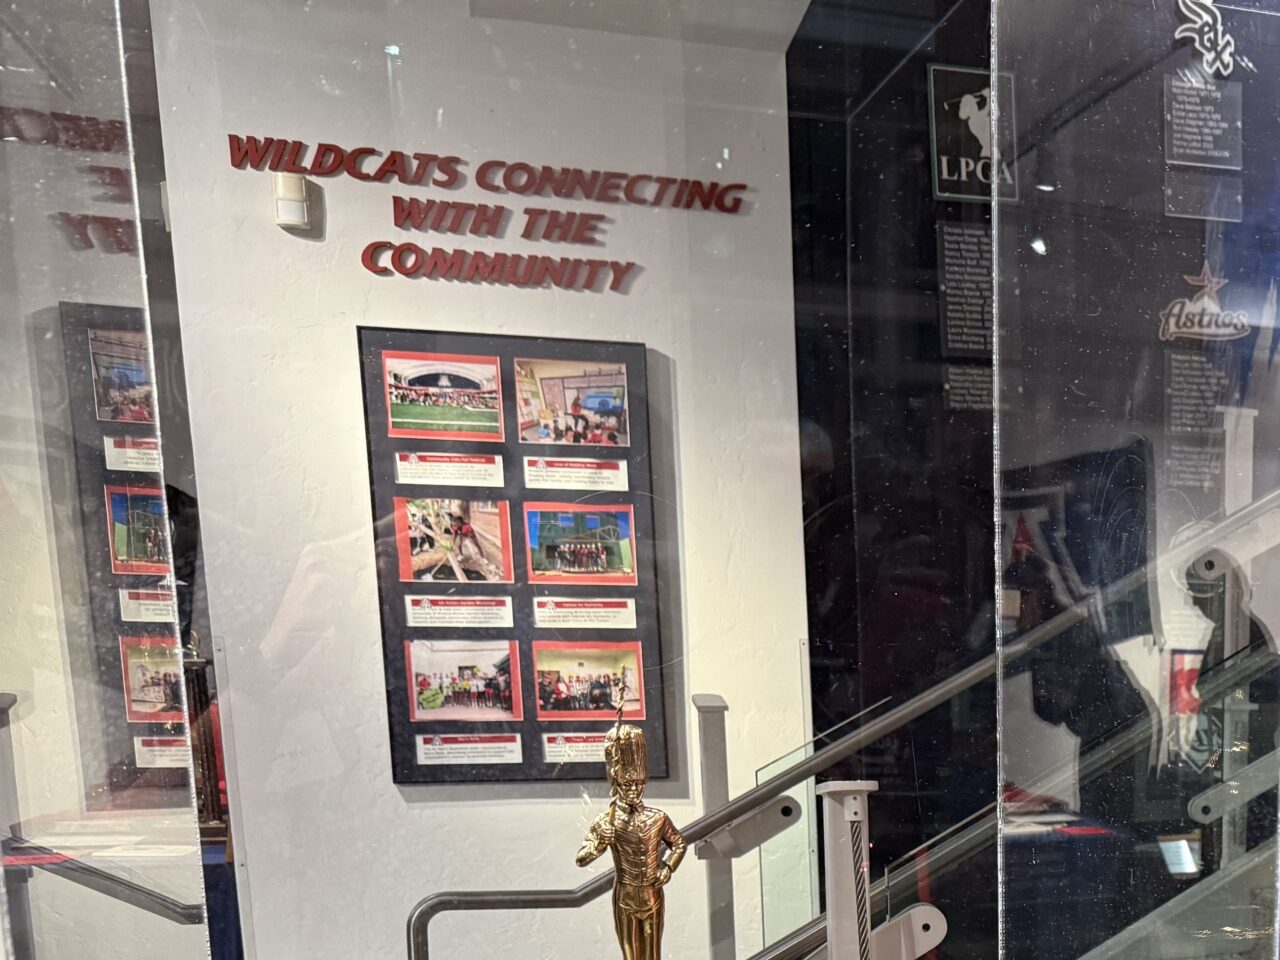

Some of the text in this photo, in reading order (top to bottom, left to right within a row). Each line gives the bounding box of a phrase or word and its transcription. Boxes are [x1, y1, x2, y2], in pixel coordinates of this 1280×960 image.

[227, 134, 748, 214] WILDCATS CONNECTING
[940, 156, 1014, 185] LPGA
[392, 196, 606, 245] WITH THE
[361, 241, 637, 293] COMMUNITY
[1160, 299, 1248, 338] Astros
